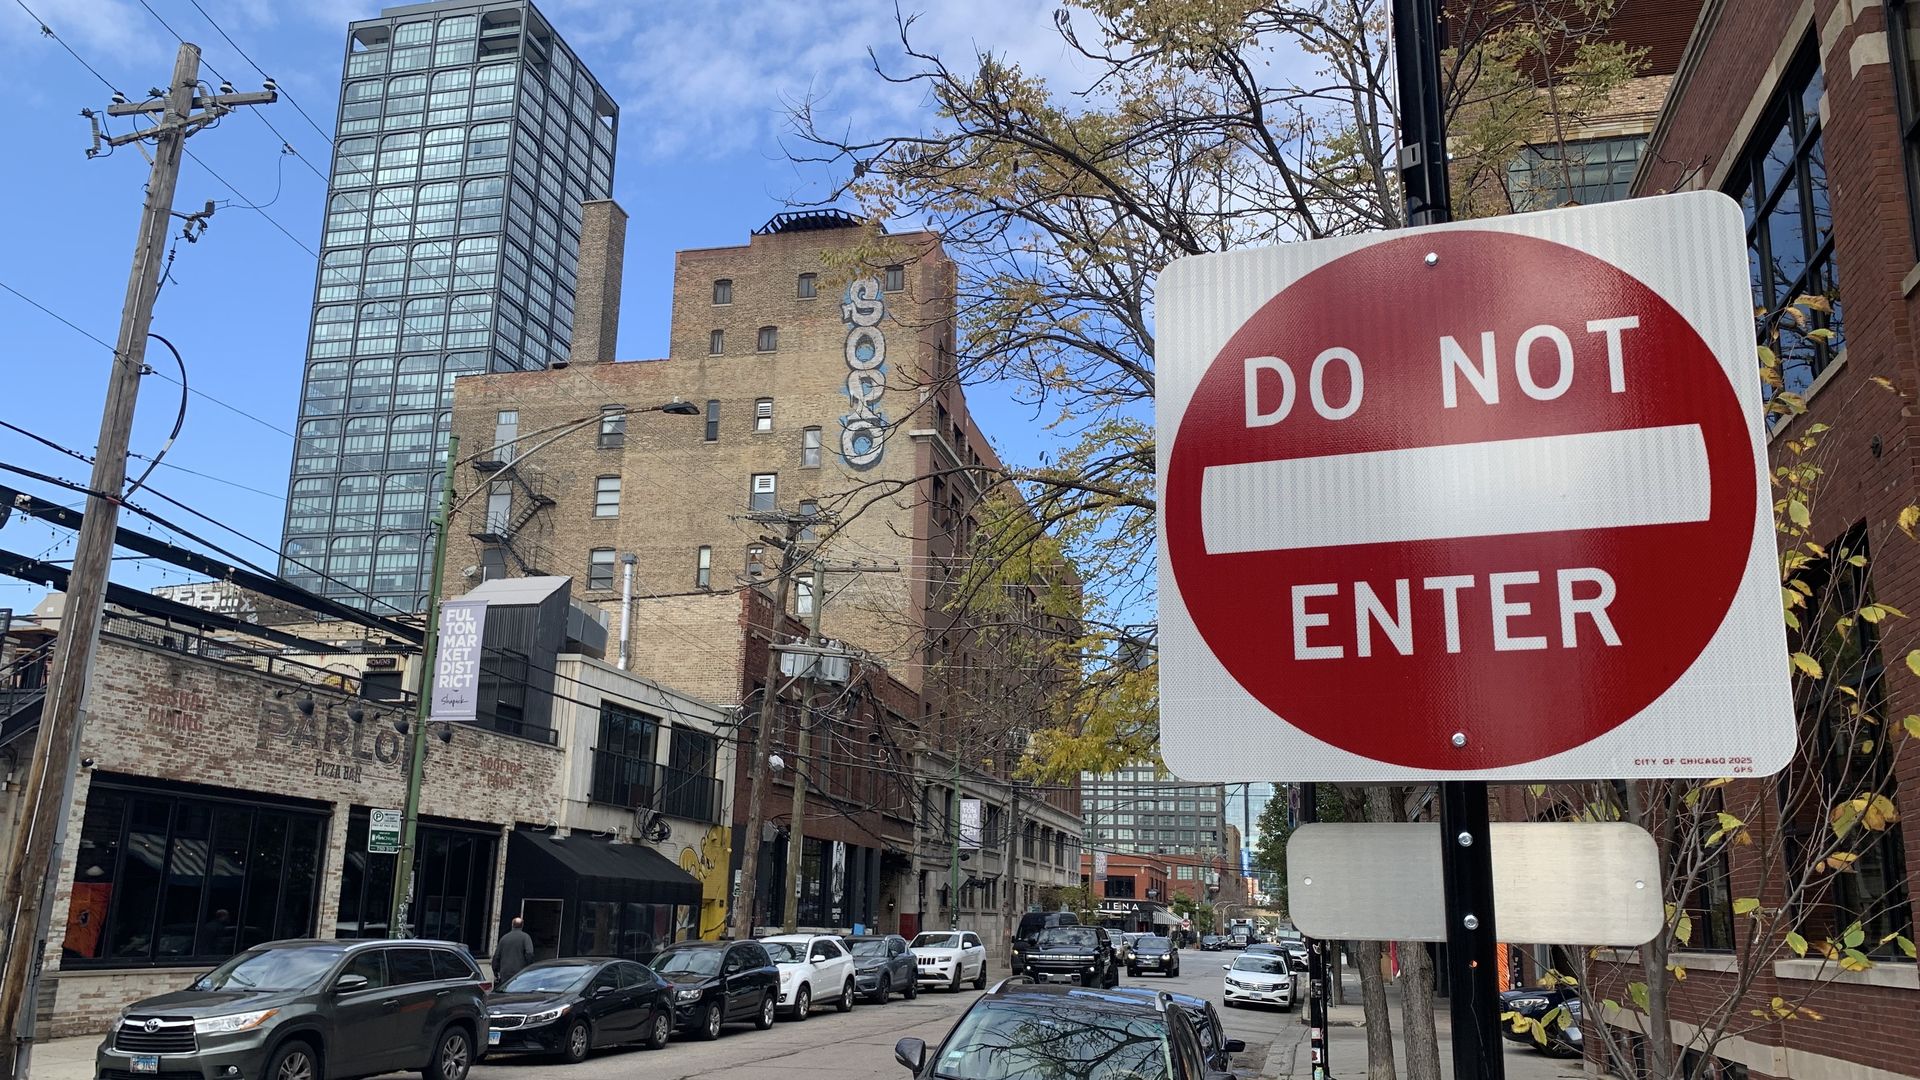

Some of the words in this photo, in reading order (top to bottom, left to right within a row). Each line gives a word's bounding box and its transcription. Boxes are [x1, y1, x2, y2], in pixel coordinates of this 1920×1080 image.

[1243, 346, 1365, 429] DO
[1439, 315, 1640, 410] NOT
[446, 608, 475, 622] FUL
[1290, 566, 1623, 662] ENTER
[446, 622, 477, 635] TON
[443, 635, 478, 648] MAR
[441, 648, 472, 662] KET
[440, 661, 475, 675] DIST
[439, 674, 473, 688] RICT
[1634, 757, 1657, 766] CITY
[1679, 757, 1726, 765] CHICAGO
[1728, 756, 1753, 764] 2025
[314, 758, 341, 780] PIZZA
[343, 766, 362, 784] BAR
[1097, 902, 1140, 911] SIENA
